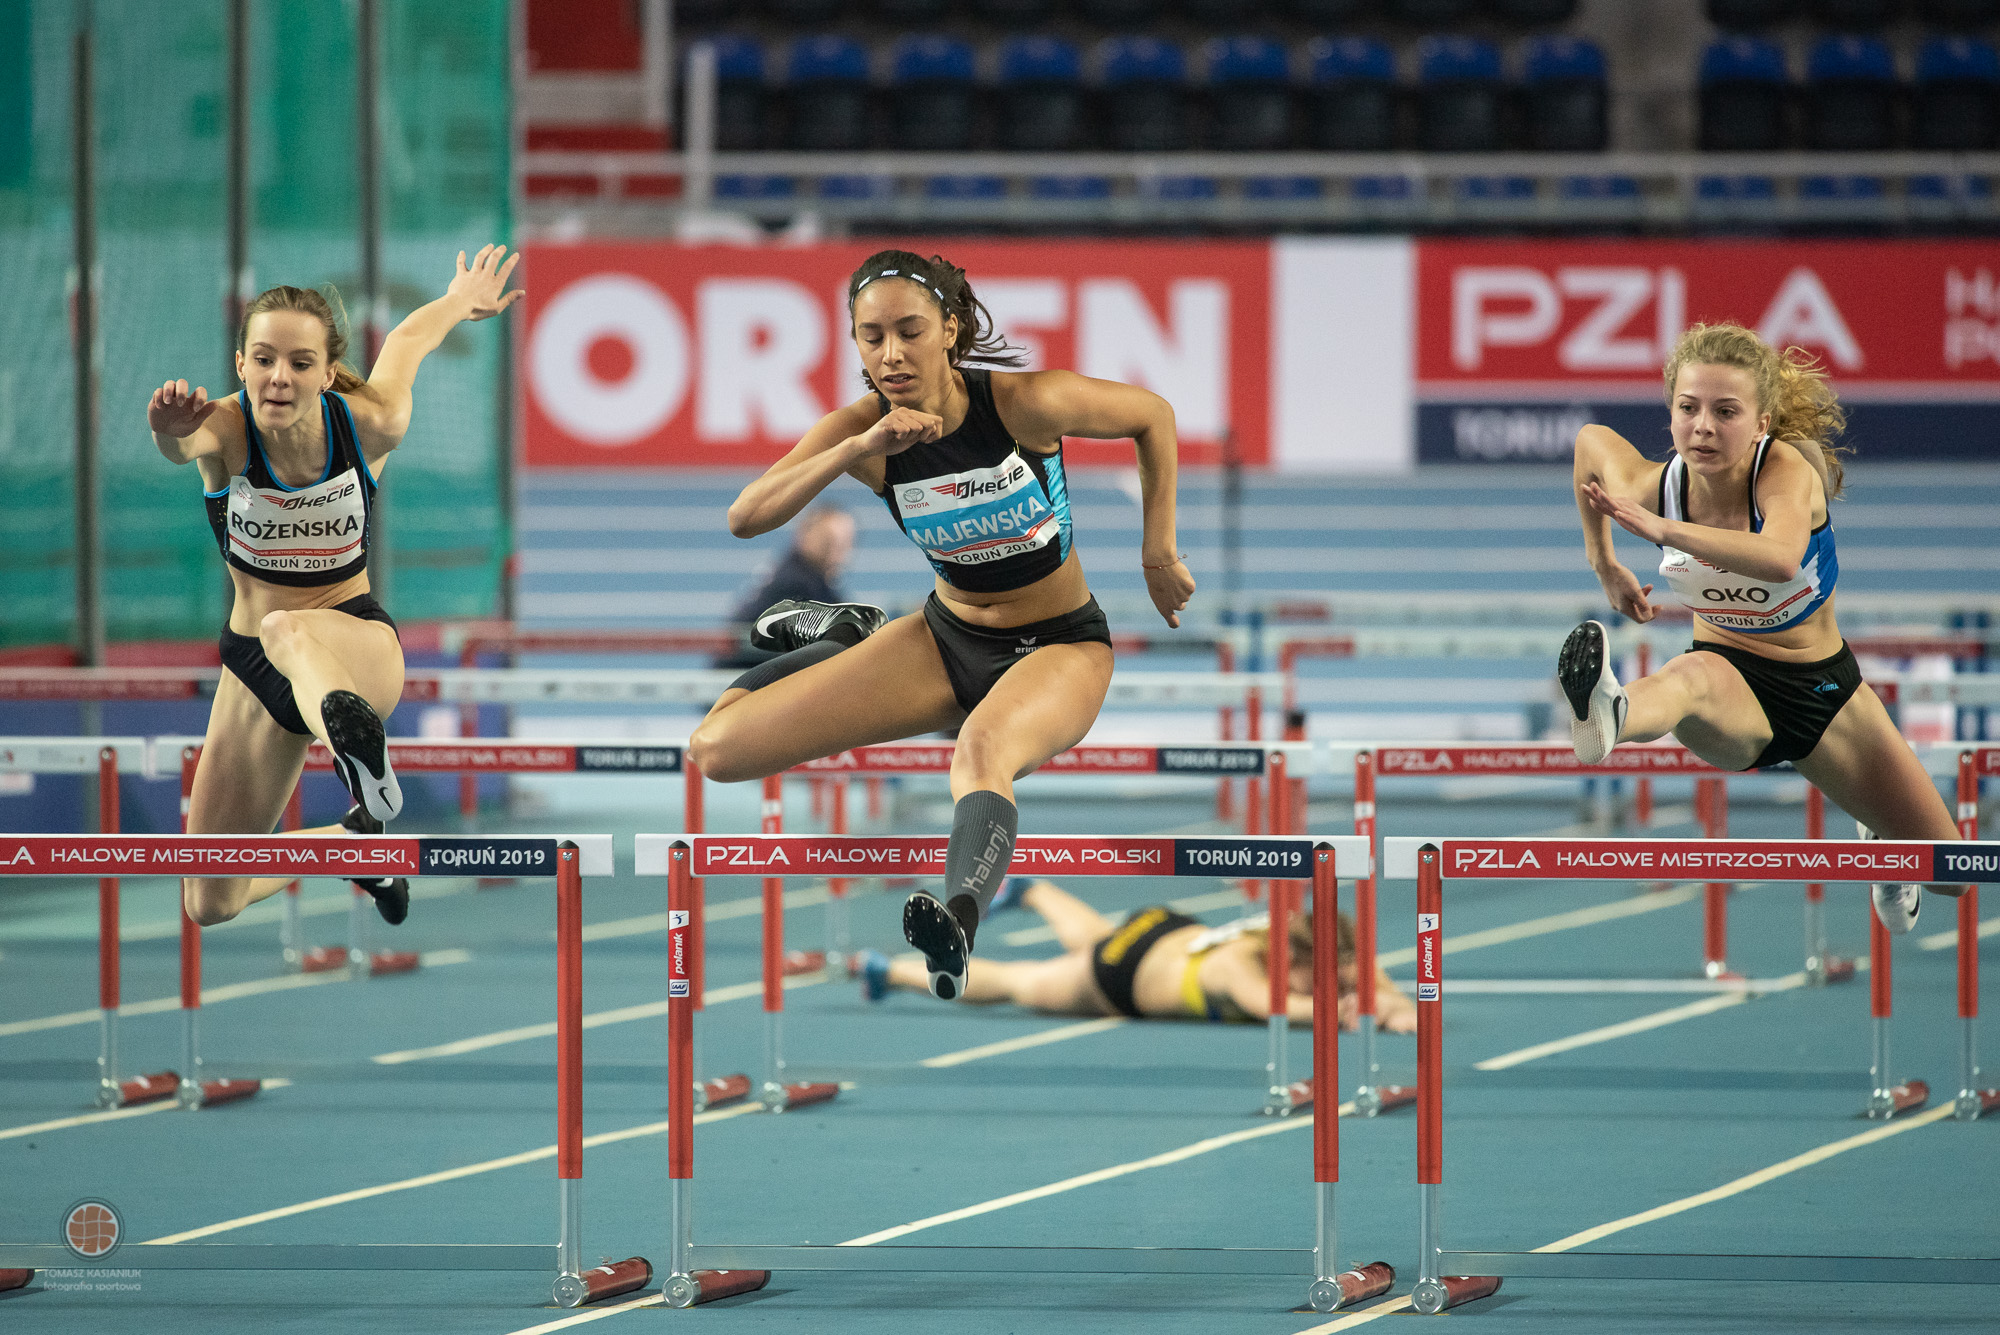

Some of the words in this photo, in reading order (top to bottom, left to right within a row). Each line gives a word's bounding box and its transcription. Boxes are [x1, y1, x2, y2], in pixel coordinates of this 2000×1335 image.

[905, 501, 930, 510] TOYOTA
[231, 510, 359, 540] ROŻEŃSKA
[911, 496, 1046, 546] MAJEWSKA
[252, 556, 299, 569] TORUŃ
[304, 557, 337, 569] 2019
[953, 546, 1001, 564] TORUŃ
[1005, 541, 1037, 555] 2019
[1702, 587, 1770, 604] OKO
[1707, 614, 1755, 627] TORUŃ
[1758, 610, 1790, 627] 2019
[1383, 750, 1453, 771] PZLA
[51, 848, 146, 863] HALOWE
[152, 848, 320, 863] MISTRZOSTWA
[325, 848, 406, 864] POLSKI
[430, 846, 495, 866] TORUŃ
[500, 849, 546, 865] 2019
[706, 846, 791, 866] PZLA
[806, 848, 901, 863] HALOWE
[907, 848, 1075, 864] MISSTWA
[1081, 848, 1161, 864] POLSKI
[1186, 846, 1252, 866] TORUŃ
[1256, 849, 1302, 867] 2019
[1455, 848, 1541, 869] PZLA
[1557, 851, 1654, 867] HALOWE
[1659, 852, 1831, 868] MISTRZOSTWA
[1837, 853, 1919, 869] POLSKI
[1945, 854, 2000, 872] TORU
[673, 932, 685, 975] polanik
[1422, 936, 1435, 979] polanik
